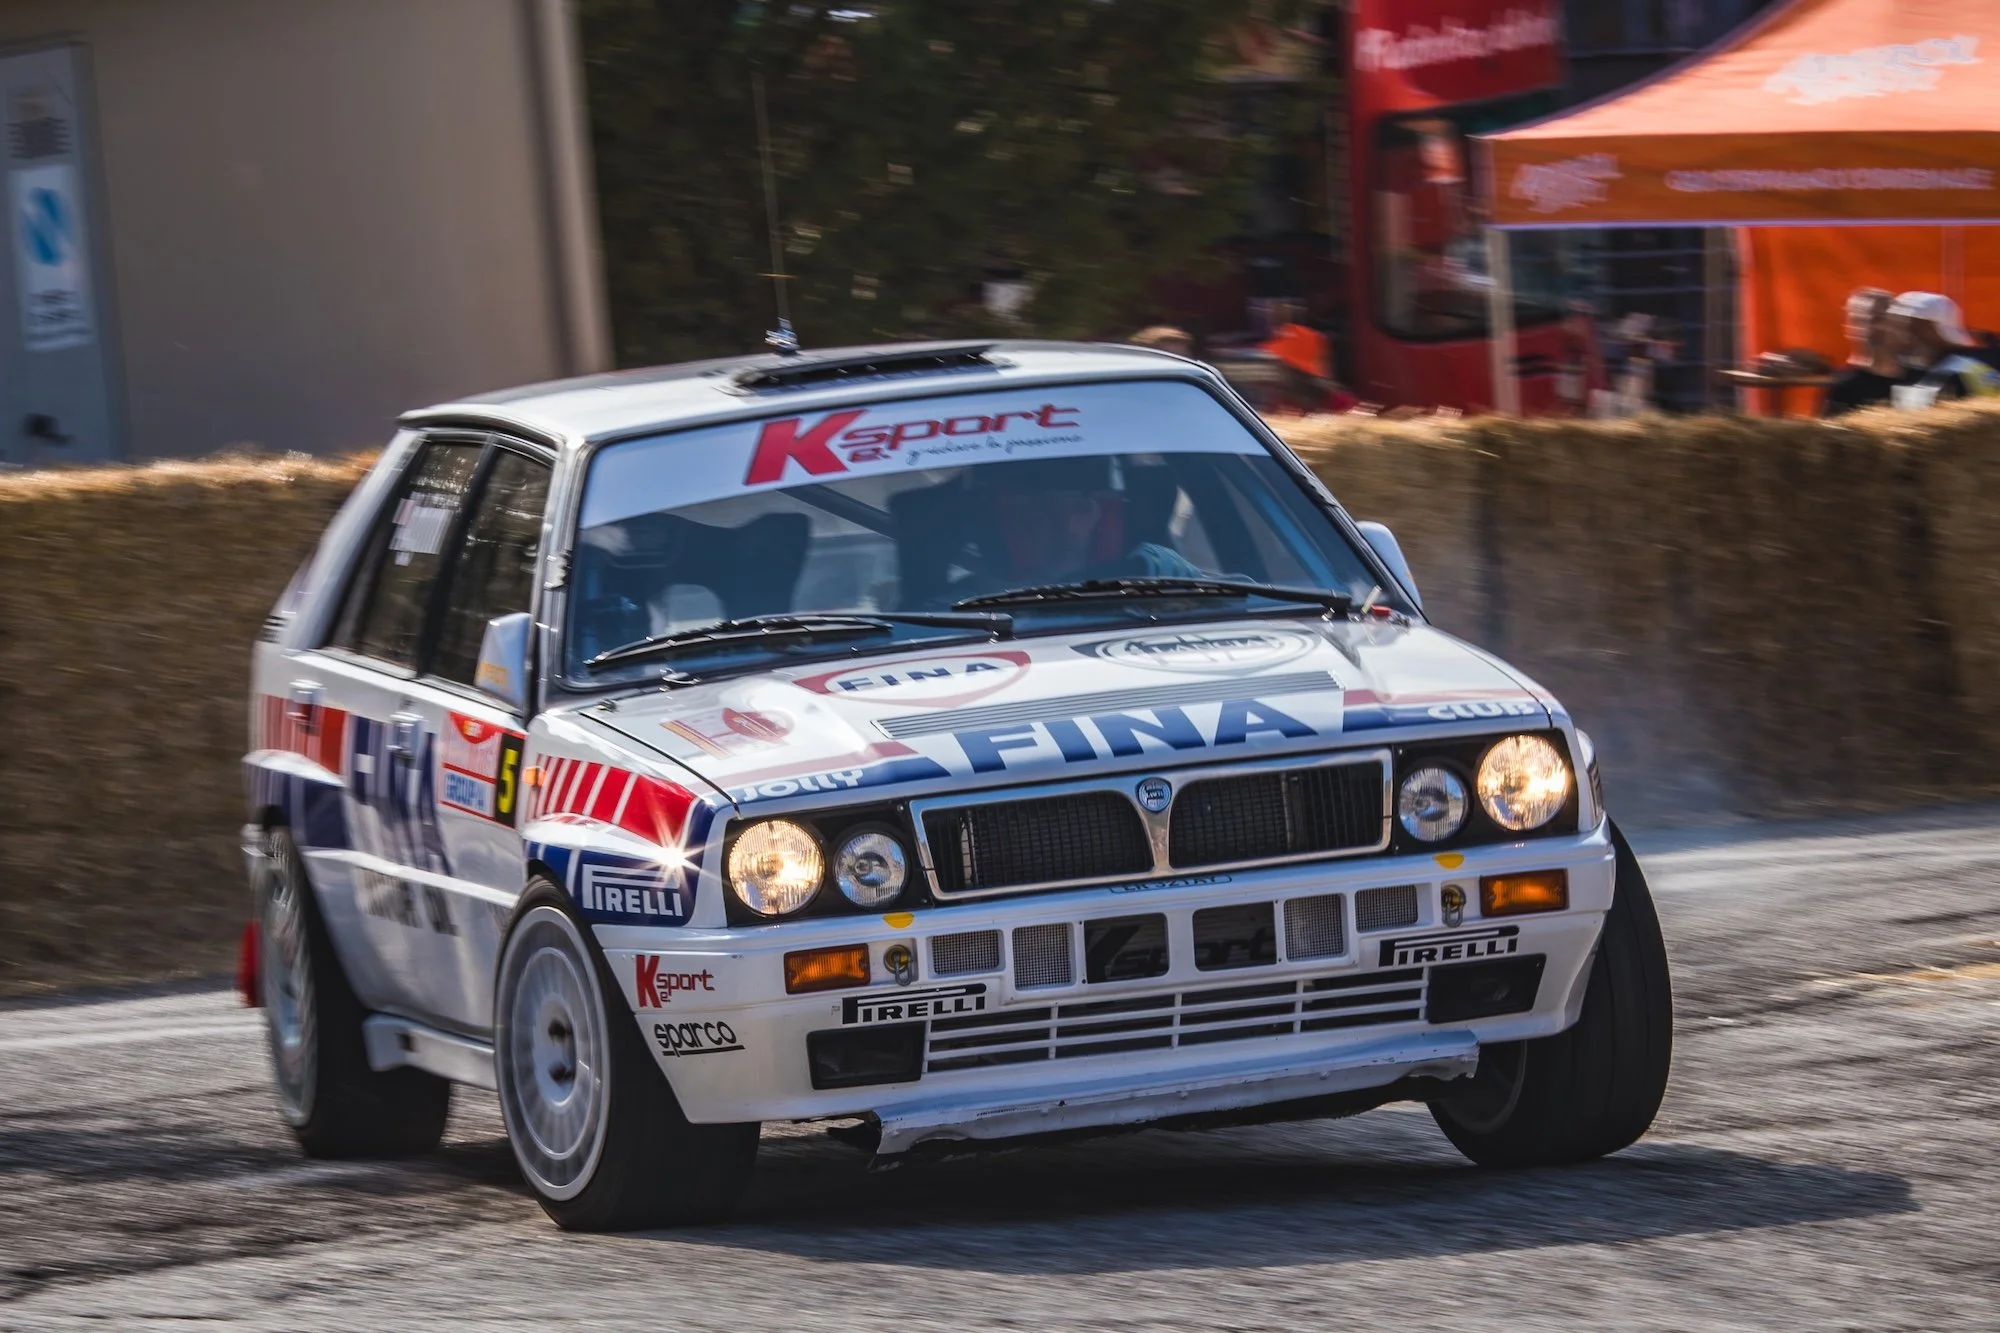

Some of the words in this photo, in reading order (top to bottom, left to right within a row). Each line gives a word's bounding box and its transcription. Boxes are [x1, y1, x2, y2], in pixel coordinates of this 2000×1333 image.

[837, 661, 1001, 692] FINA
[950, 698, 1320, 775] FINA
[498, 748, 519, 814] 5
[743, 768, 865, 801] JOLLY
[582, 863, 684, 917] PIRELLI
[1378, 925, 1520, 968] PIRELLI
[842, 983, 987, 1025] PIRELLI
[654, 1020, 738, 1057] sparco
